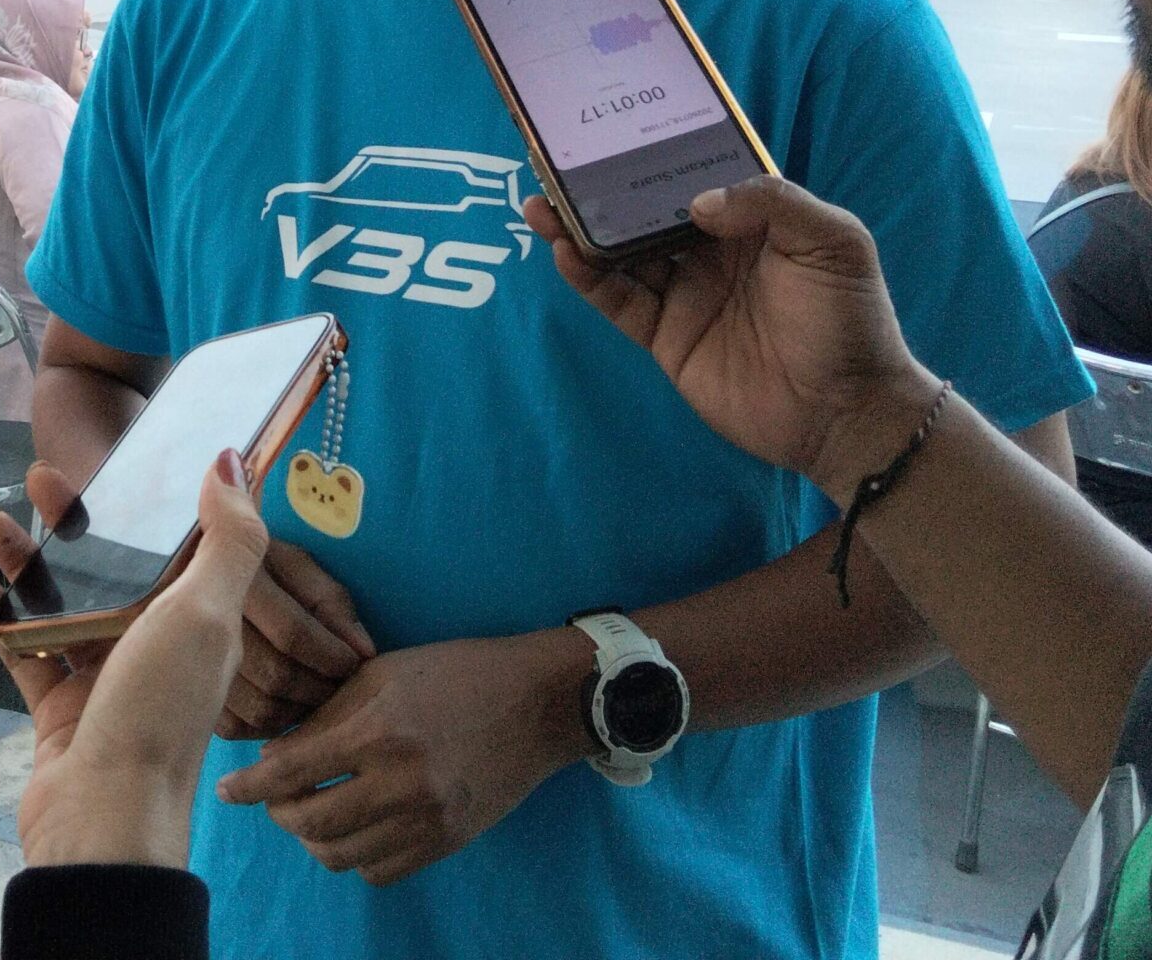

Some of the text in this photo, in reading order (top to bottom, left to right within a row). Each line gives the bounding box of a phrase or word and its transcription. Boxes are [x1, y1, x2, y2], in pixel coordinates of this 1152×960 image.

[581, 86, 666, 124] 00:01:17
[630, 150, 740, 189] Perekam Suara
[277, 214, 512, 309] V3S
